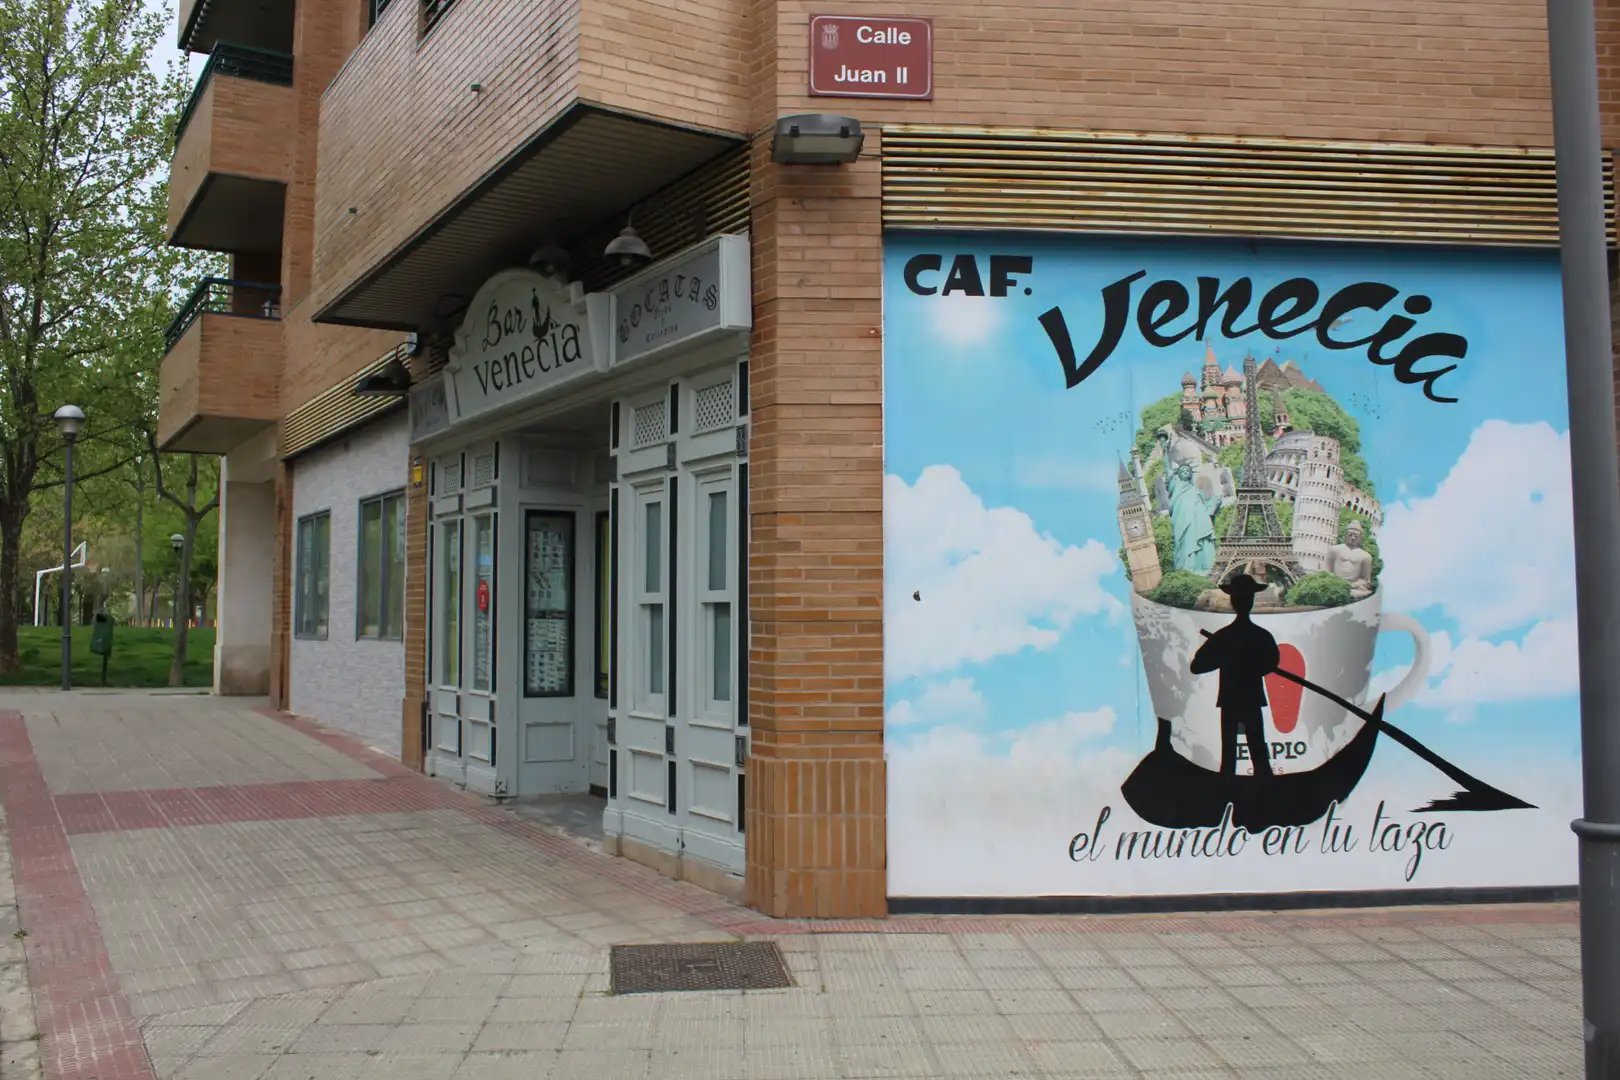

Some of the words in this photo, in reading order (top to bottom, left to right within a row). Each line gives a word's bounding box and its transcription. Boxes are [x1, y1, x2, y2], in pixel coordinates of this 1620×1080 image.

[856, 25, 912, 45] Calle
[834, 64, 886, 83] Juan
[896, 66, 908, 84] II
[903, 253, 1033, 298] CAF.
[482, 299, 528, 353] Bar
[618, 273, 719, 344] BOCATAS
[473, 322, 583, 397] venecia
[1037, 269, 1469, 403] Venecia
[1236, 740, 1307, 761] EPLO
[1068, 805, 1112, 862] el
[1115, 802, 1251, 860] mundo
[1262, 826, 1310, 856] en
[1320, 800, 1359, 854] tu
[1369, 800, 1454, 882] taza
